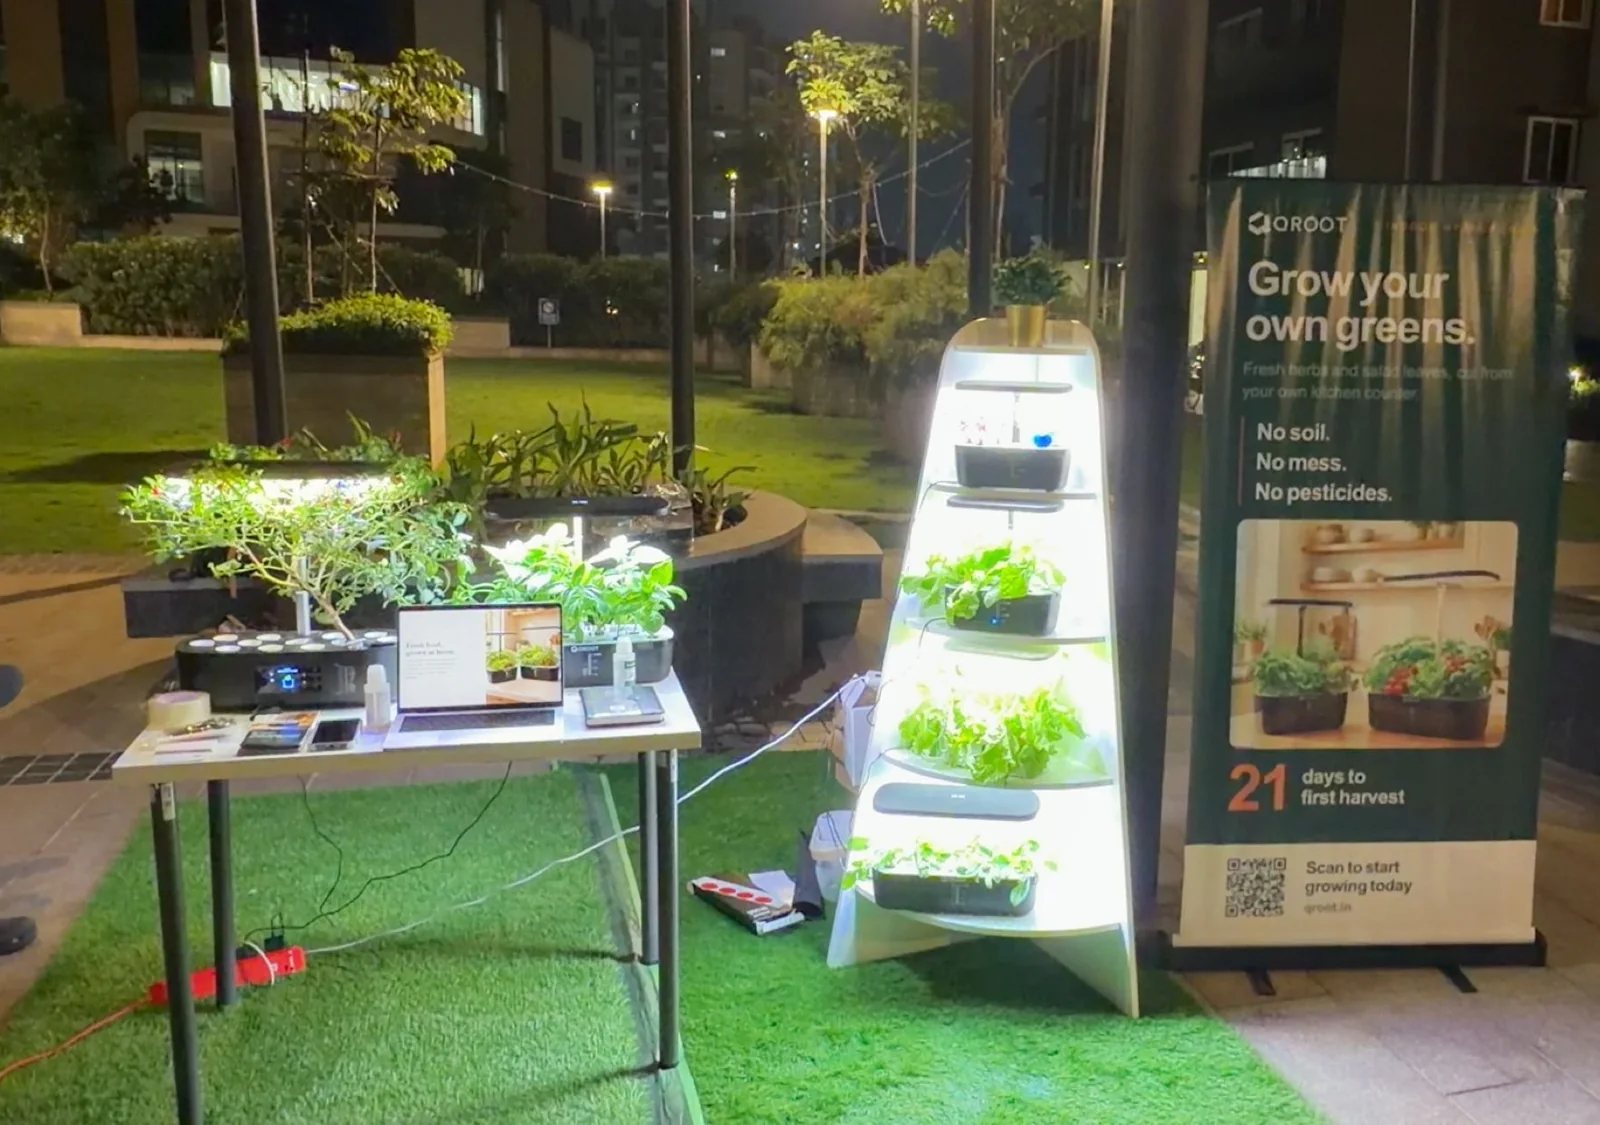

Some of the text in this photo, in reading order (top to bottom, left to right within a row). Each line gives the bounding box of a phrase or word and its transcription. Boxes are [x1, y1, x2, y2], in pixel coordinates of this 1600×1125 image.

[1248, 260, 1450, 307] Grow your
[1245, 314, 1476, 351] own greens.
[1242, 387, 1274, 400] your
[1257, 422, 1330, 442] No soil.
[1256, 452, 1347, 472] No mess.
[1255, 482, 1393, 506] No pesticides.
[1227, 763, 1286, 812] 21
[1302, 768, 1367, 787] days to
[1301, 789, 1405, 805] first harvest
[1306, 861, 1400, 874] Scan to start
[1305, 879, 1413, 896] growing today
